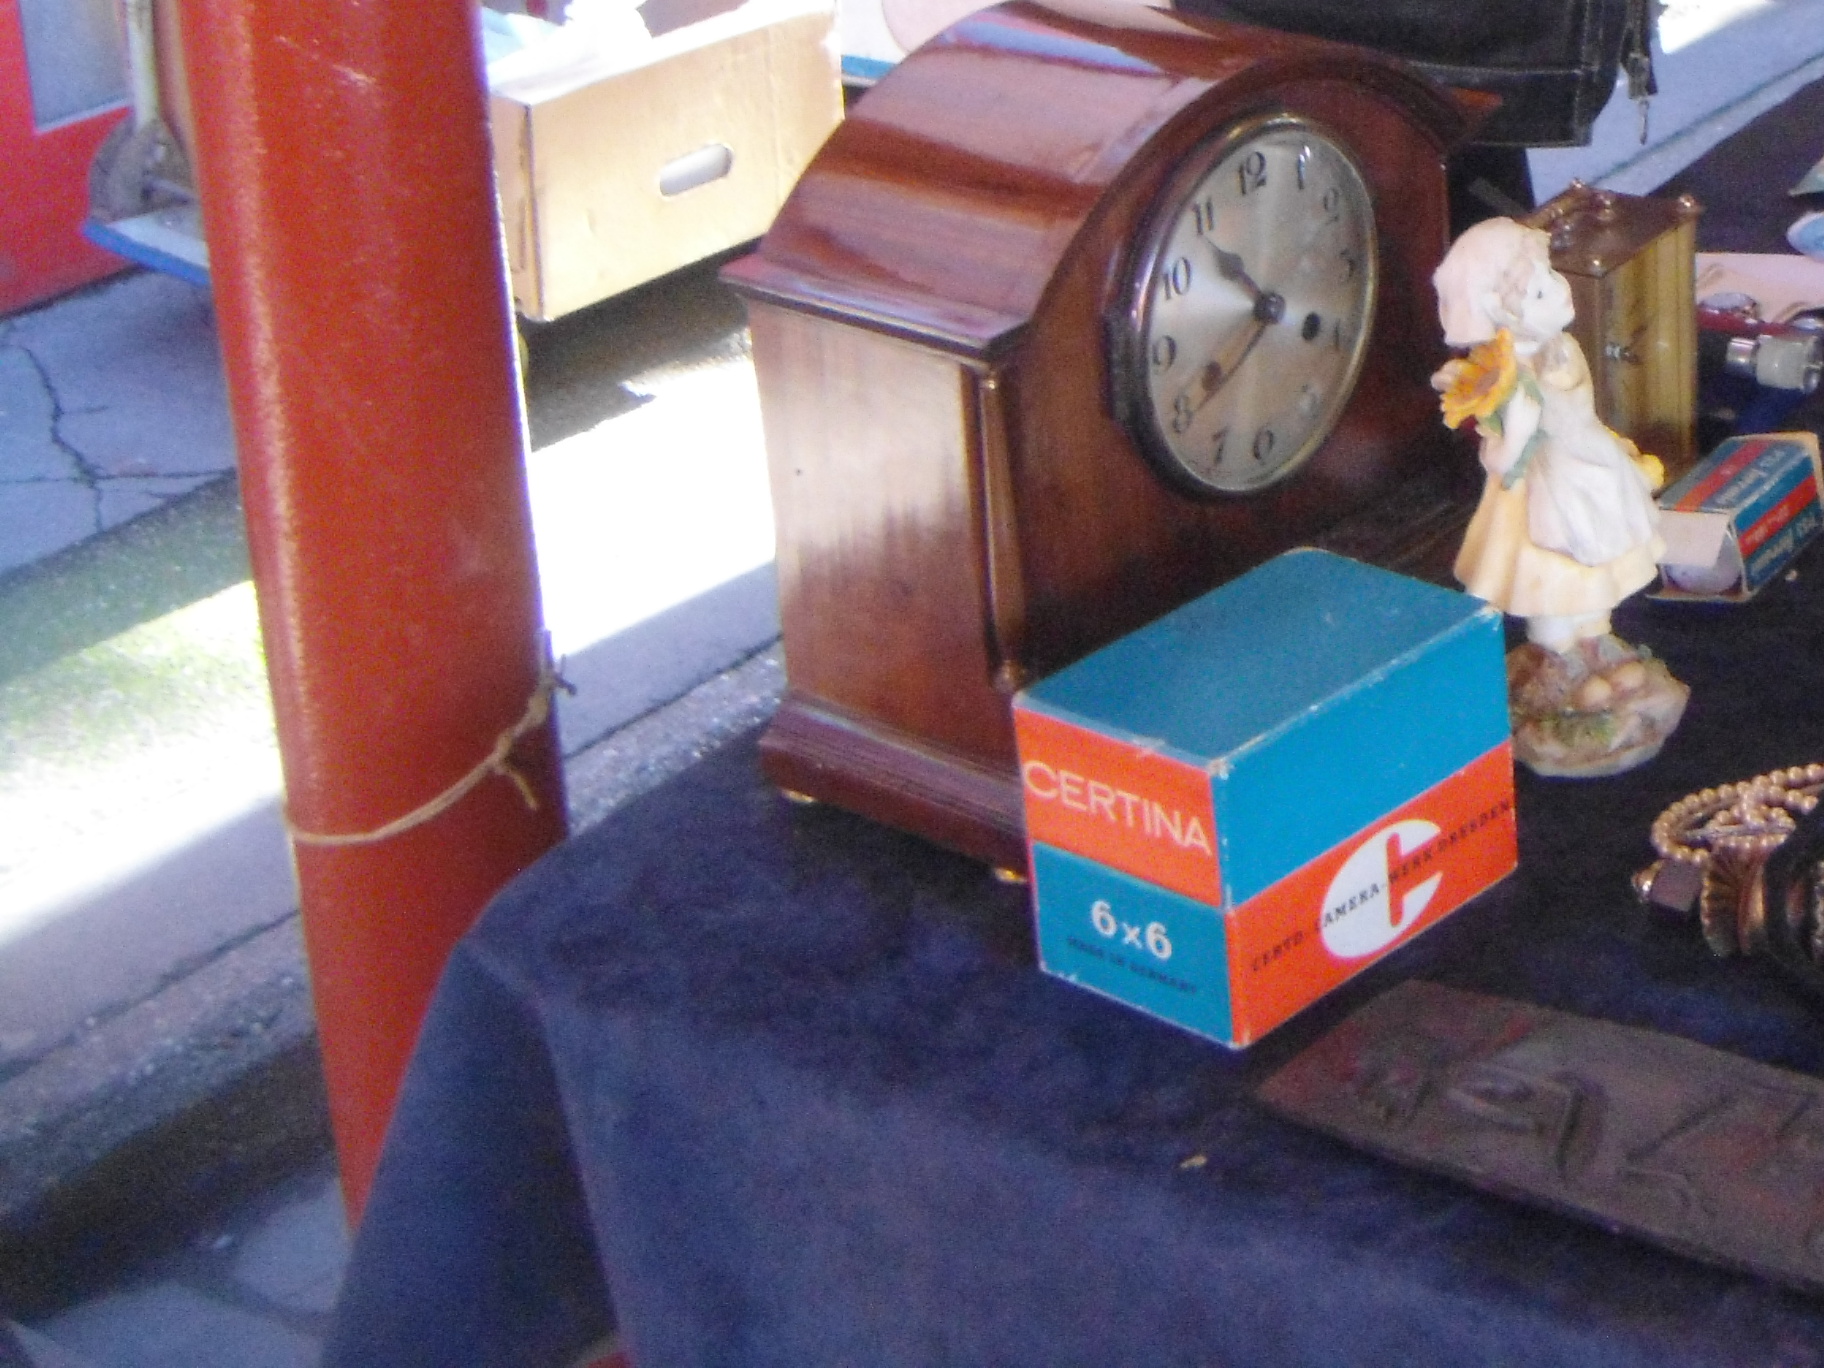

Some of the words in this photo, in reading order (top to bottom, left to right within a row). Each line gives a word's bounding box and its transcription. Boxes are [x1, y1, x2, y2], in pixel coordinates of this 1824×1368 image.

[1238, 151, 1267, 195] 12
[1193, 198, 1214, 235] 11
[1323, 187, 1340, 225] 2
[1163, 256, 1192, 301] 10
[1152, 334, 1177, 372] 9
[1171, 393, 1194, 434] 8
[1022, 759, 1213, 857] CERTINA
[1091, 899, 1173, 961] 6x6
